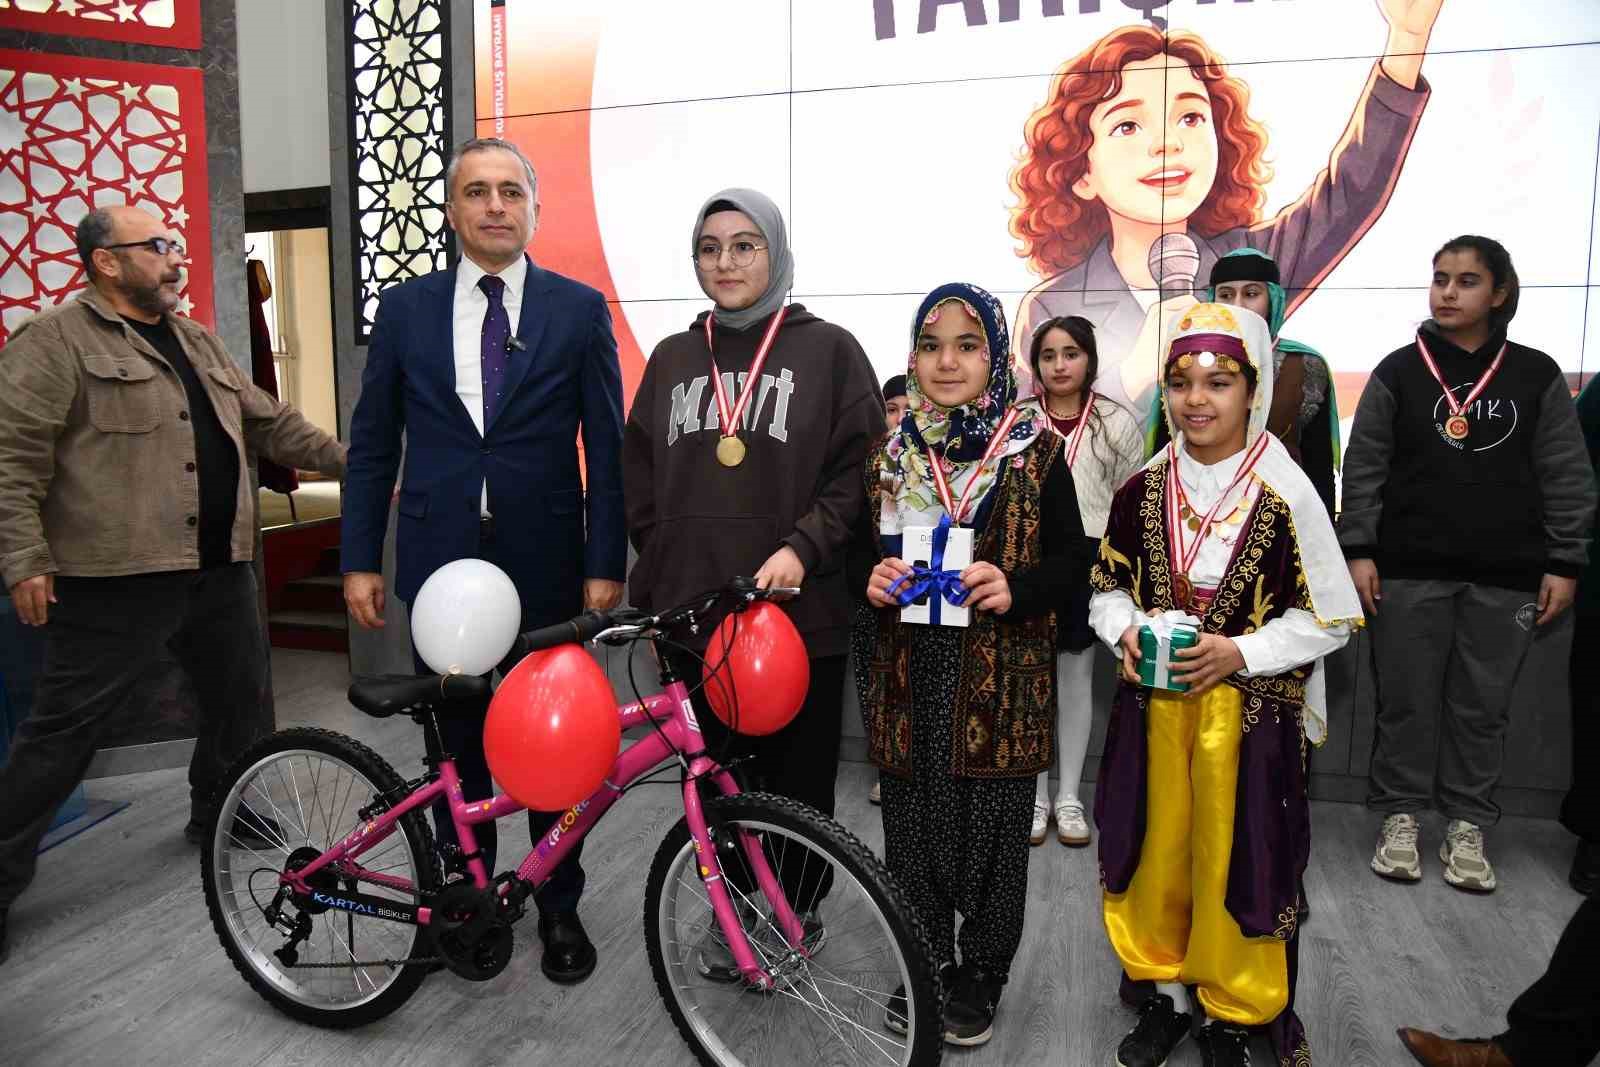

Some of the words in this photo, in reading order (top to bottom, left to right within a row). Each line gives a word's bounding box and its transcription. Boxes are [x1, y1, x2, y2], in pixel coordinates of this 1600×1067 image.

[494, 69, 505, 133] KURTULUŞ
[667, 368, 795, 447] MAVİ
[313, 891, 376, 914] KARTAL
